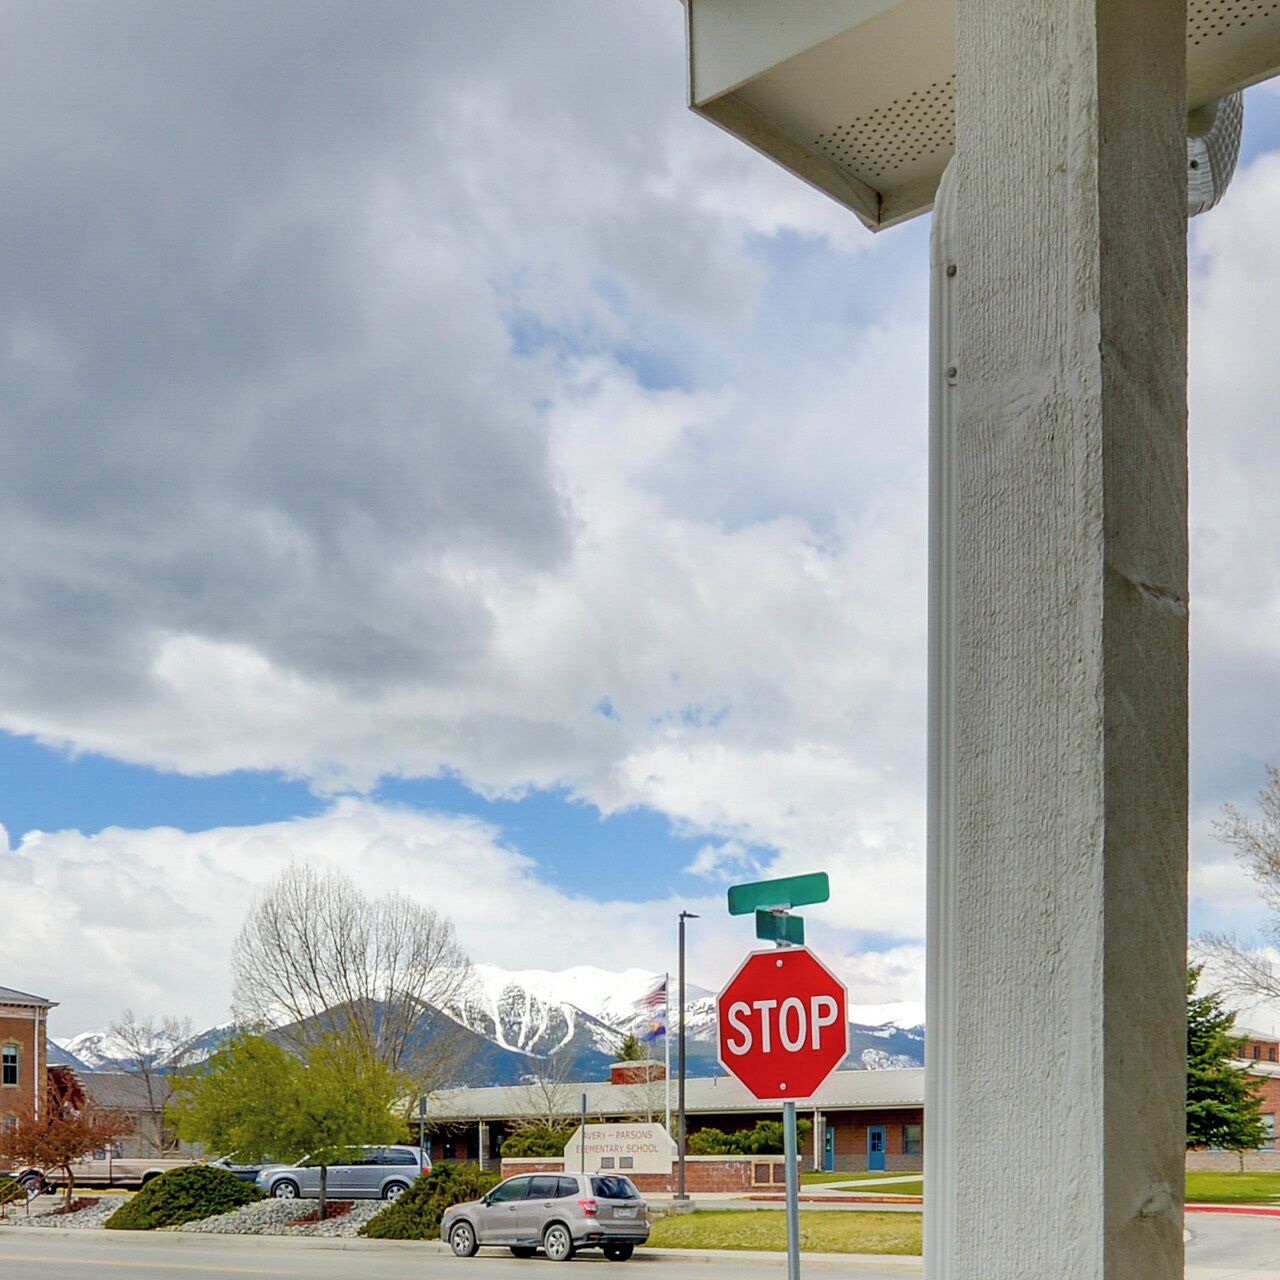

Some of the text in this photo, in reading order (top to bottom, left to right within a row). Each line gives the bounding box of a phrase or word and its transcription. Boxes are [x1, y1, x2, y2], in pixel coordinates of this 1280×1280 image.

[726, 995, 838, 1055] STOP
[616, 1130, 653, 1140] PARSONS
[576, 1143, 658, 1153] EEMENTARY SCHOOL
